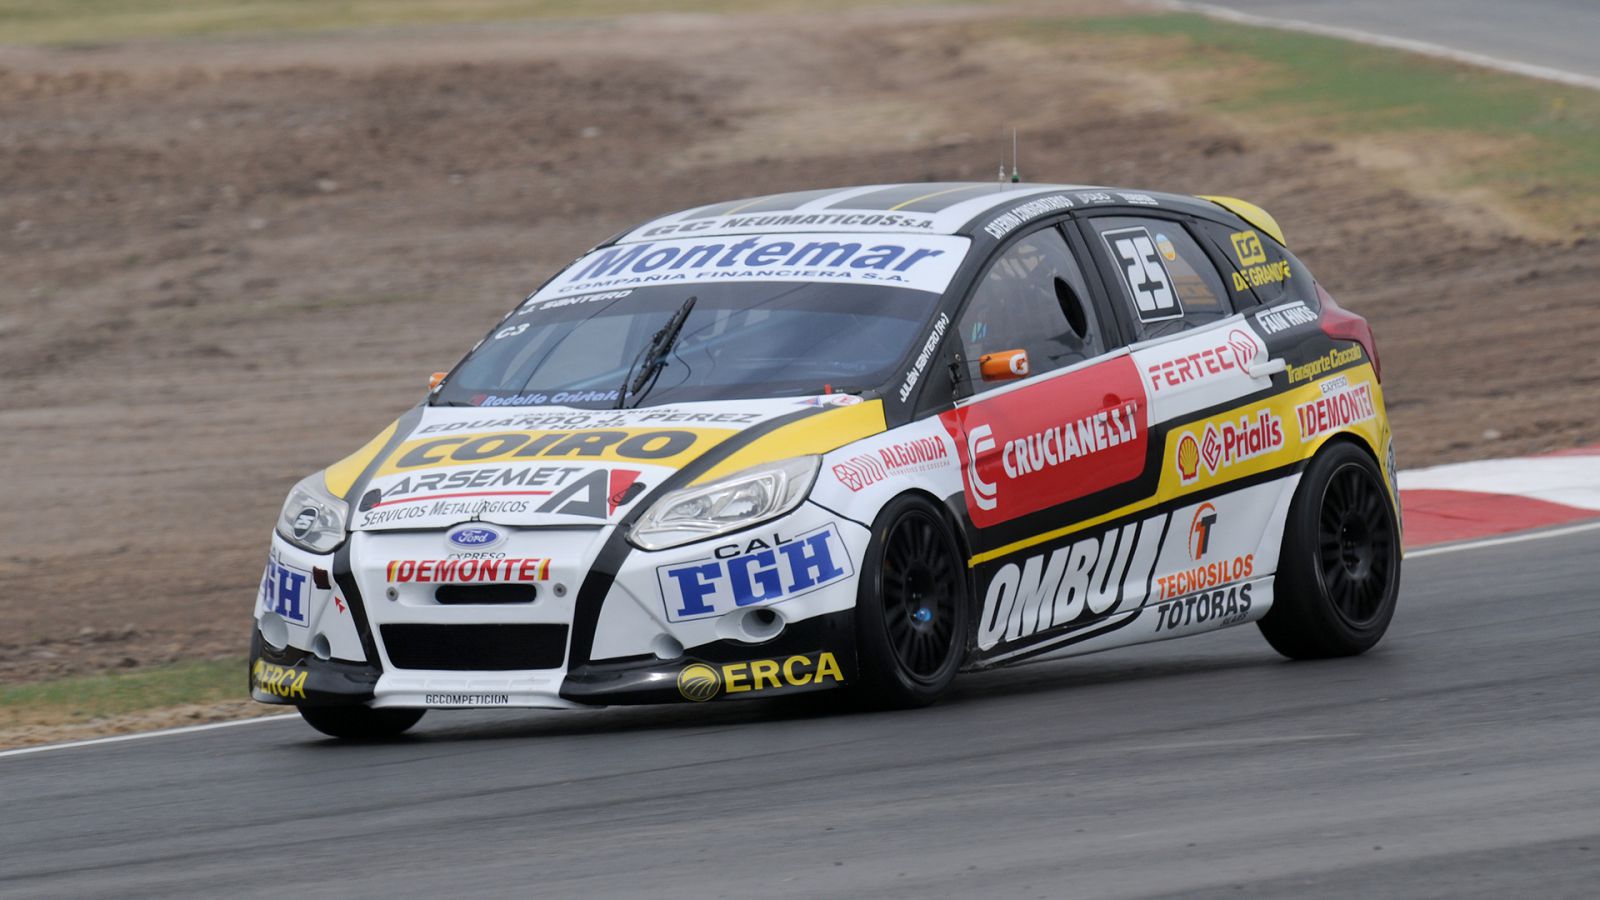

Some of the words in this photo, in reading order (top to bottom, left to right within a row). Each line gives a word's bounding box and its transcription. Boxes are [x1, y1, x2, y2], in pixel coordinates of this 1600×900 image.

[569, 236, 945, 282] Montemar
[1115, 236, 1175, 311] 25
[1249, 260, 1292, 287] GRANDE
[696, 268, 853, 281] FINANCIERA
[861, 272, 910, 284] S.A.
[494, 322, 531, 340] C3
[1148, 345, 1234, 391] FERTEC
[1286, 355, 1331, 385] Transporte
[1321, 375, 1347, 393] EXPRESO
[481, 393, 548, 407] Rodolfo
[1306, 386, 1371, 436] DEMONTE
[418, 415, 590, 434] EDUARDO
[645, 412, 763, 425] PEREZ
[1223, 413, 1281, 462] Prialis
[394, 430, 699, 468] COIRO
[1003, 402, 1138, 479] CRUCIANELLI
[381, 467, 585, 497] ARSEMET
[360, 505, 428, 527] SERVICIOS
[458, 530, 489, 543] Ford
[714, 533, 793, 559] CAL
[397, 558, 541, 582] DEMONTE
[668, 530, 844, 617] FGH
[1157, 554, 1253, 600] TECNOSILOS
[1155, 584, 1252, 632] TOTORAS
[261, 667, 308, 698] ERCA
[722, 652, 844, 693] ERCA
